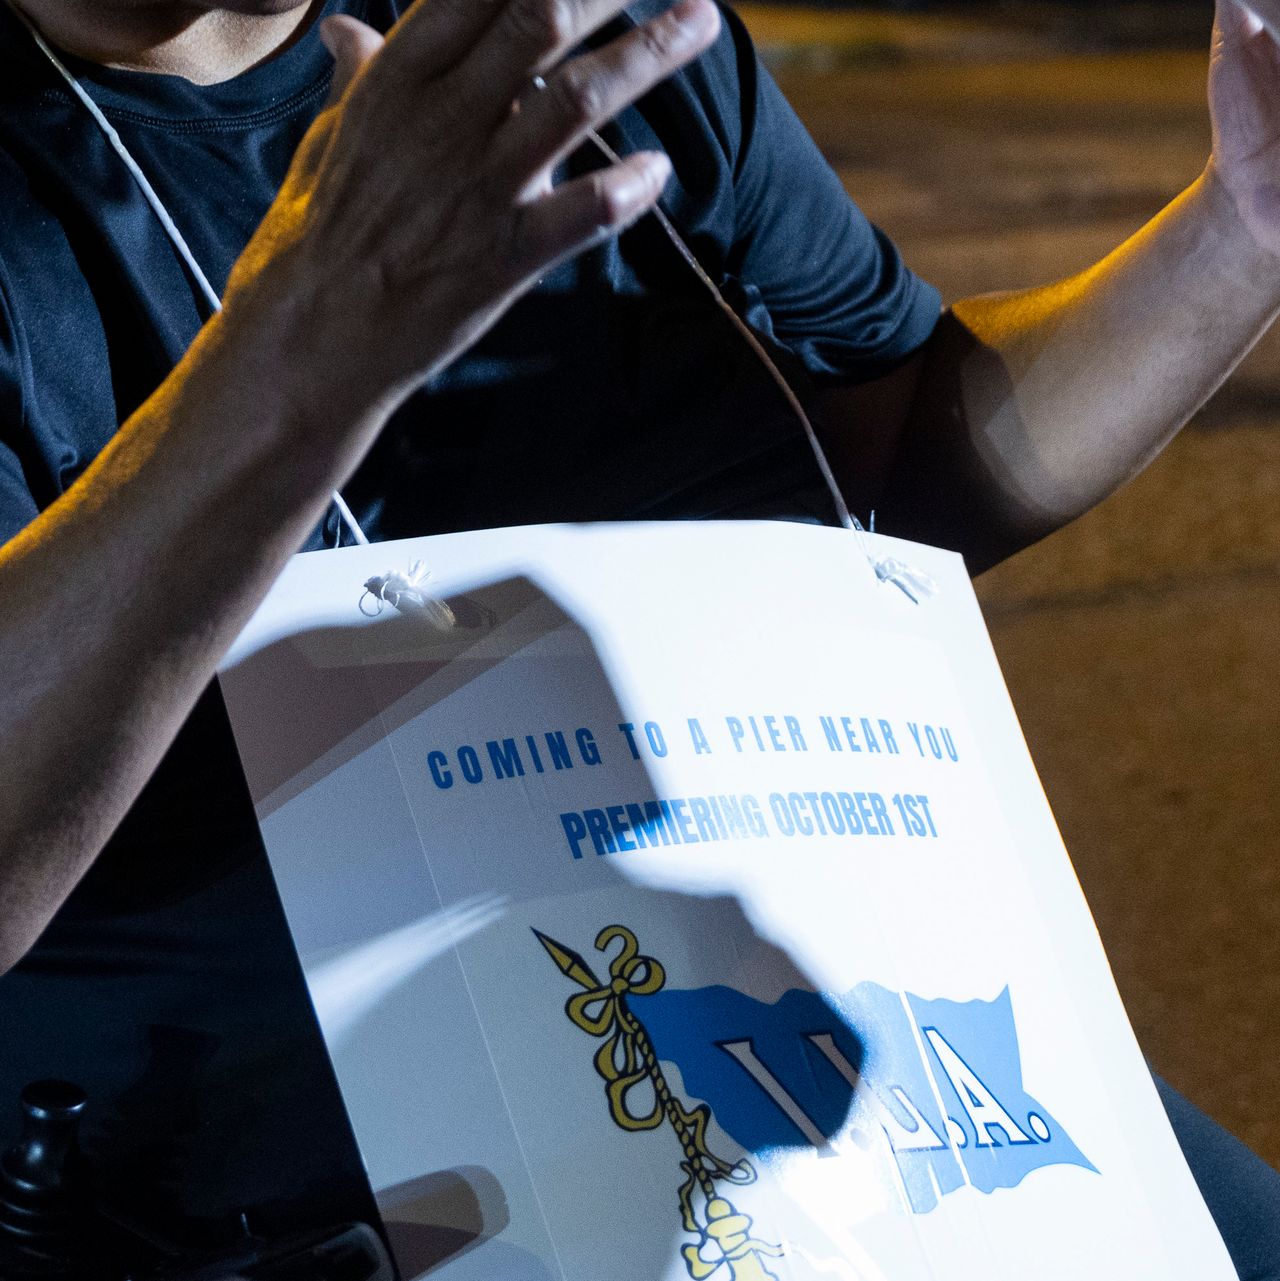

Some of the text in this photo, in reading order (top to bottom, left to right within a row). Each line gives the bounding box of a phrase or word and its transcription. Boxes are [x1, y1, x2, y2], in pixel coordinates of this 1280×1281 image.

[427, 715, 959, 789] COMING TO A PIER NEAR YOU
[560, 791, 939, 859] PREMIERING OCTOBER 1ST
